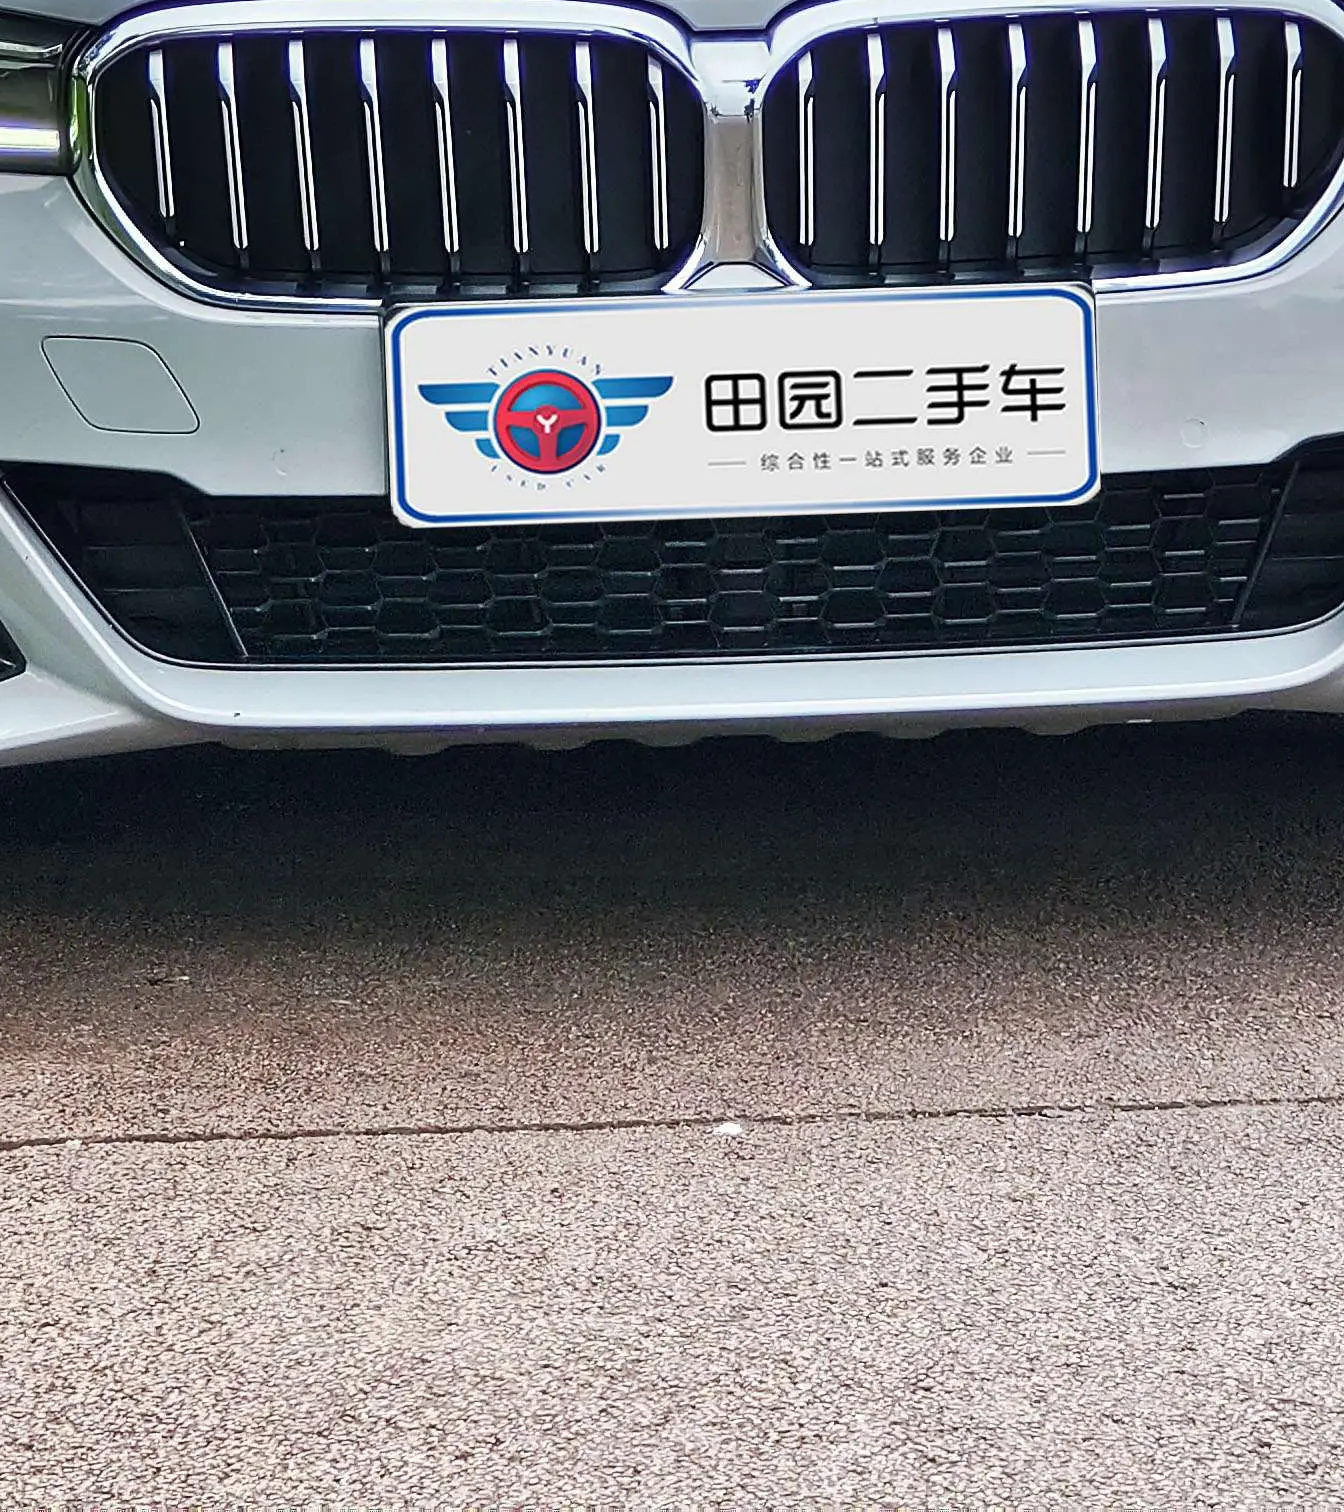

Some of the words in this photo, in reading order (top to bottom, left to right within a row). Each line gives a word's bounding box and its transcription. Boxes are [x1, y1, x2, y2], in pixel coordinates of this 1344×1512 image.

[705, 363, 1067, 432] 田园二手车
[536, 414, 558, 434] Y
[760, 446, 1014, 472] 综合性一站式服务企业
